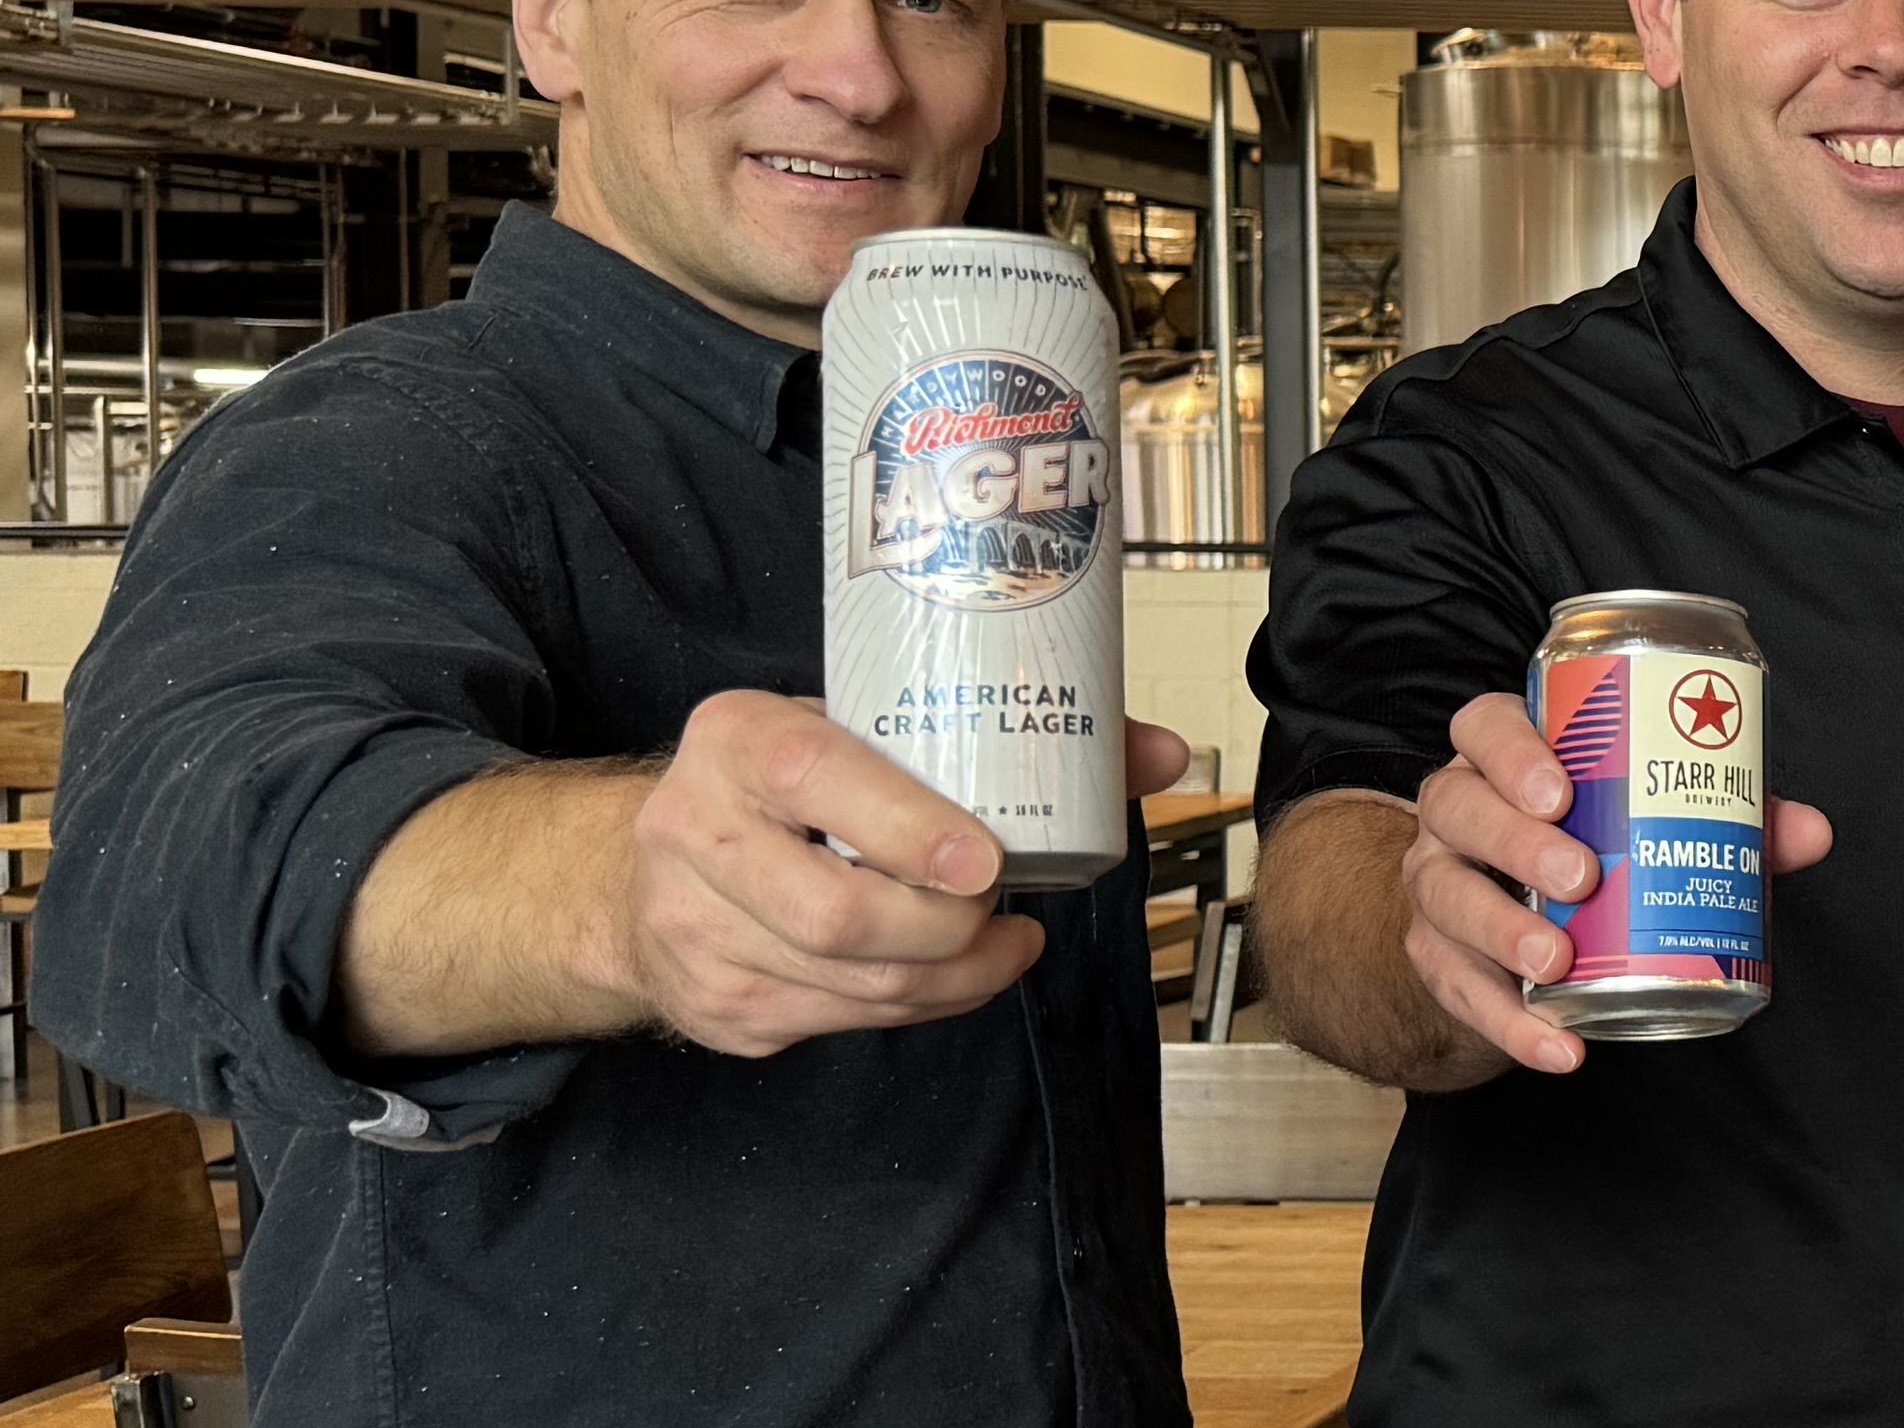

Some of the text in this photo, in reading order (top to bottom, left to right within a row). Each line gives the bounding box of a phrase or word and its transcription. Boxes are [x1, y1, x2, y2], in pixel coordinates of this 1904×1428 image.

[867, 265, 923, 281] BREW
[932, 264, 992, 279] WITH
[903, 393, 1079, 456] Richmond
[848, 438, 1110, 580] LAGER
[897, 684, 1075, 708] AMERICAN
[874, 712, 1094, 736] CRAFT LAGER
[1646, 759, 1756, 807] STARR HILL
[1639, 839, 1760, 876] RAMBLE ON
[1685, 877, 1732, 894] JUICY
[1643, 891, 1760, 913] INDIA PALE ALE
